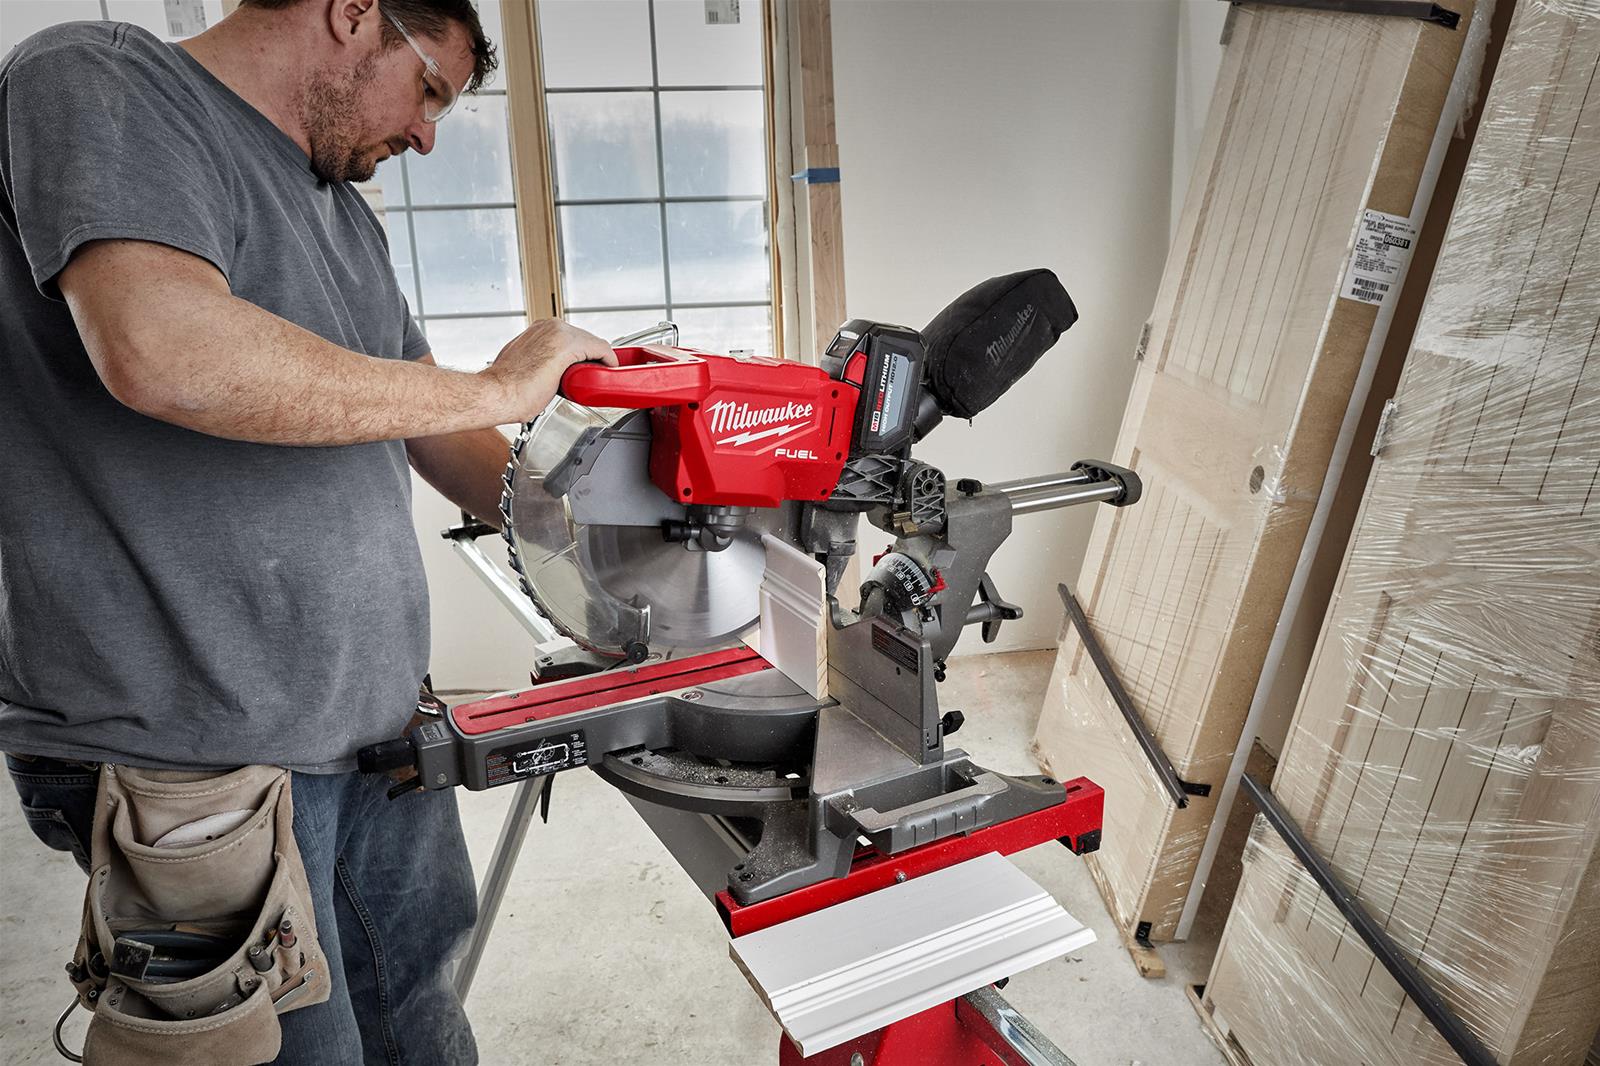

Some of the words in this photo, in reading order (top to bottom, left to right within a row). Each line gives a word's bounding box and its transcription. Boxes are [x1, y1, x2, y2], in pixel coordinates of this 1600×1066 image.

[984, 303, 1035, 366] Milwaukee
[884, 384, 894, 412] OUTPUT
[704, 399, 813, 434] Milwaukee
[871, 412, 880, 431] M18
[774, 447, 818, 460] FUEL
